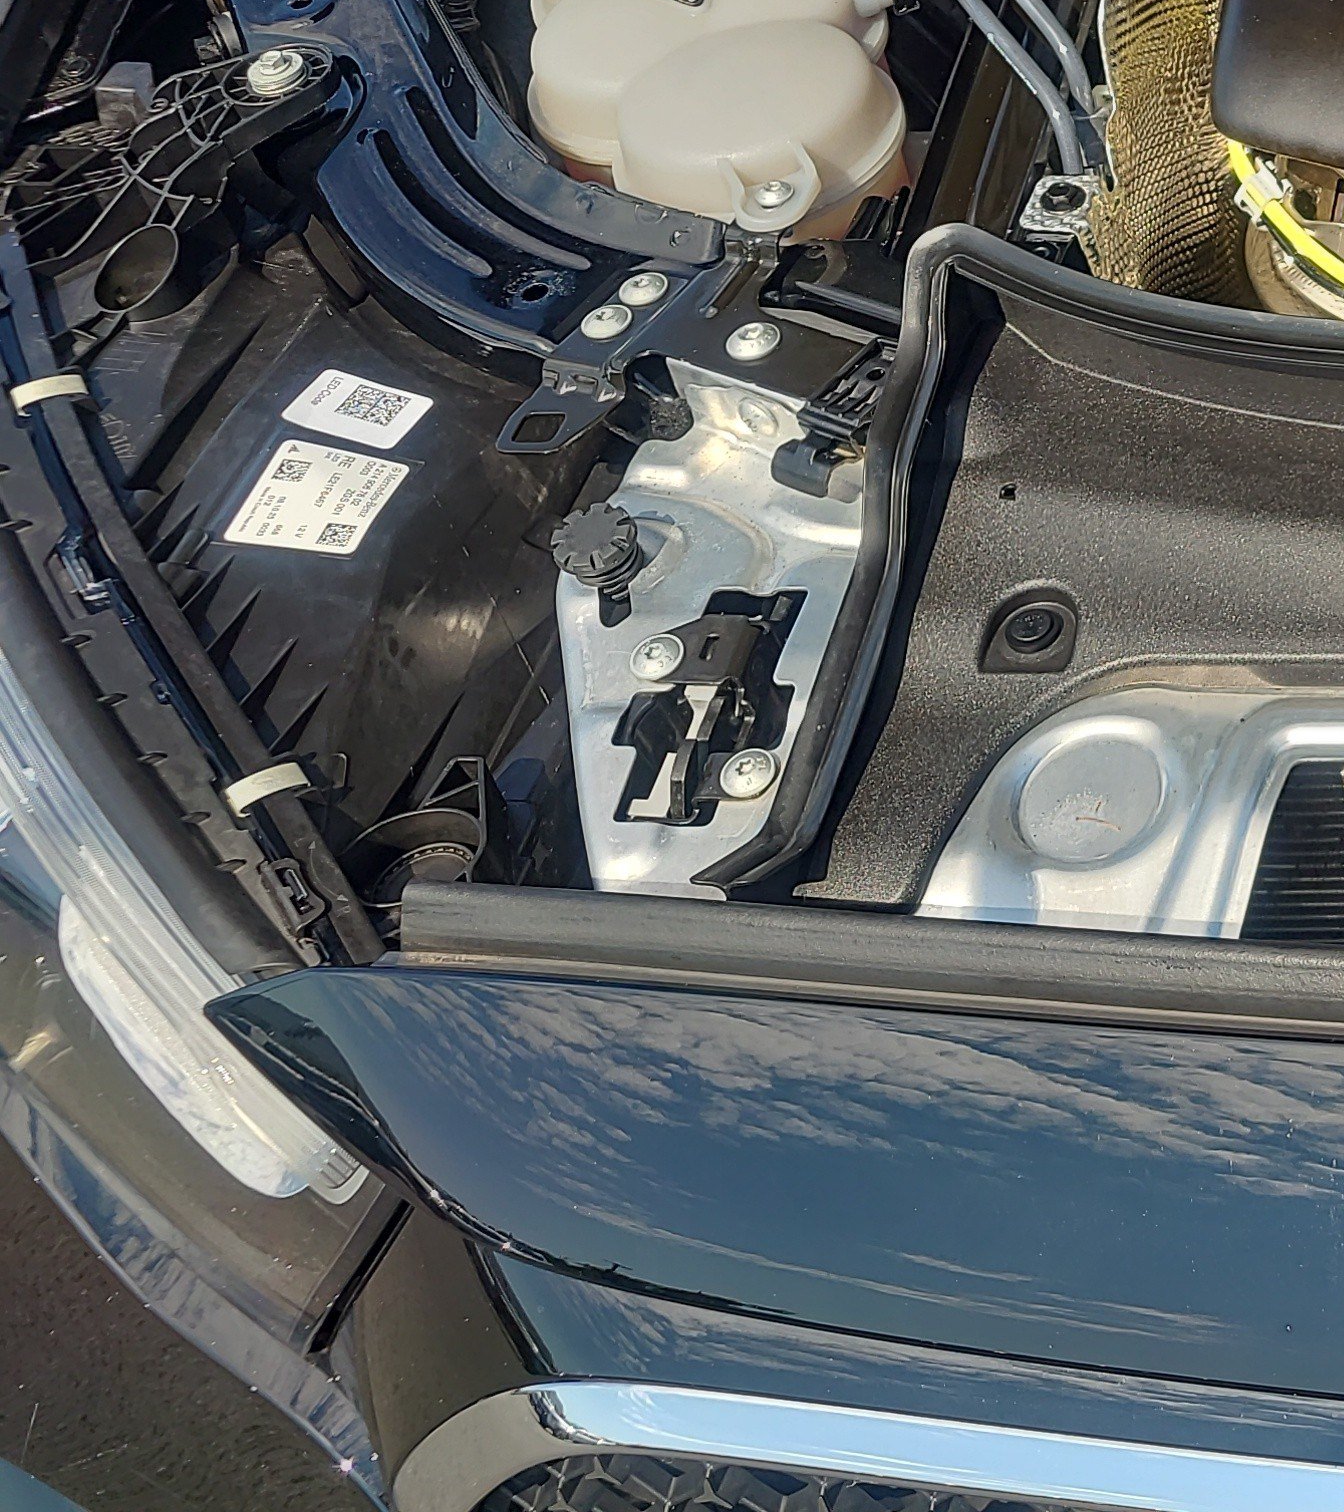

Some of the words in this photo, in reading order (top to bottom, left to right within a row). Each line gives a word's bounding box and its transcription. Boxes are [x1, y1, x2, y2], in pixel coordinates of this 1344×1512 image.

[338, 455, 356, 468] RE
[338, 488, 355, 503] ZGS
[348, 497, 362, 506] 02
[357, 472, 397, 519] Mercedes-Benz
[331, 503, 345, 515] 001
